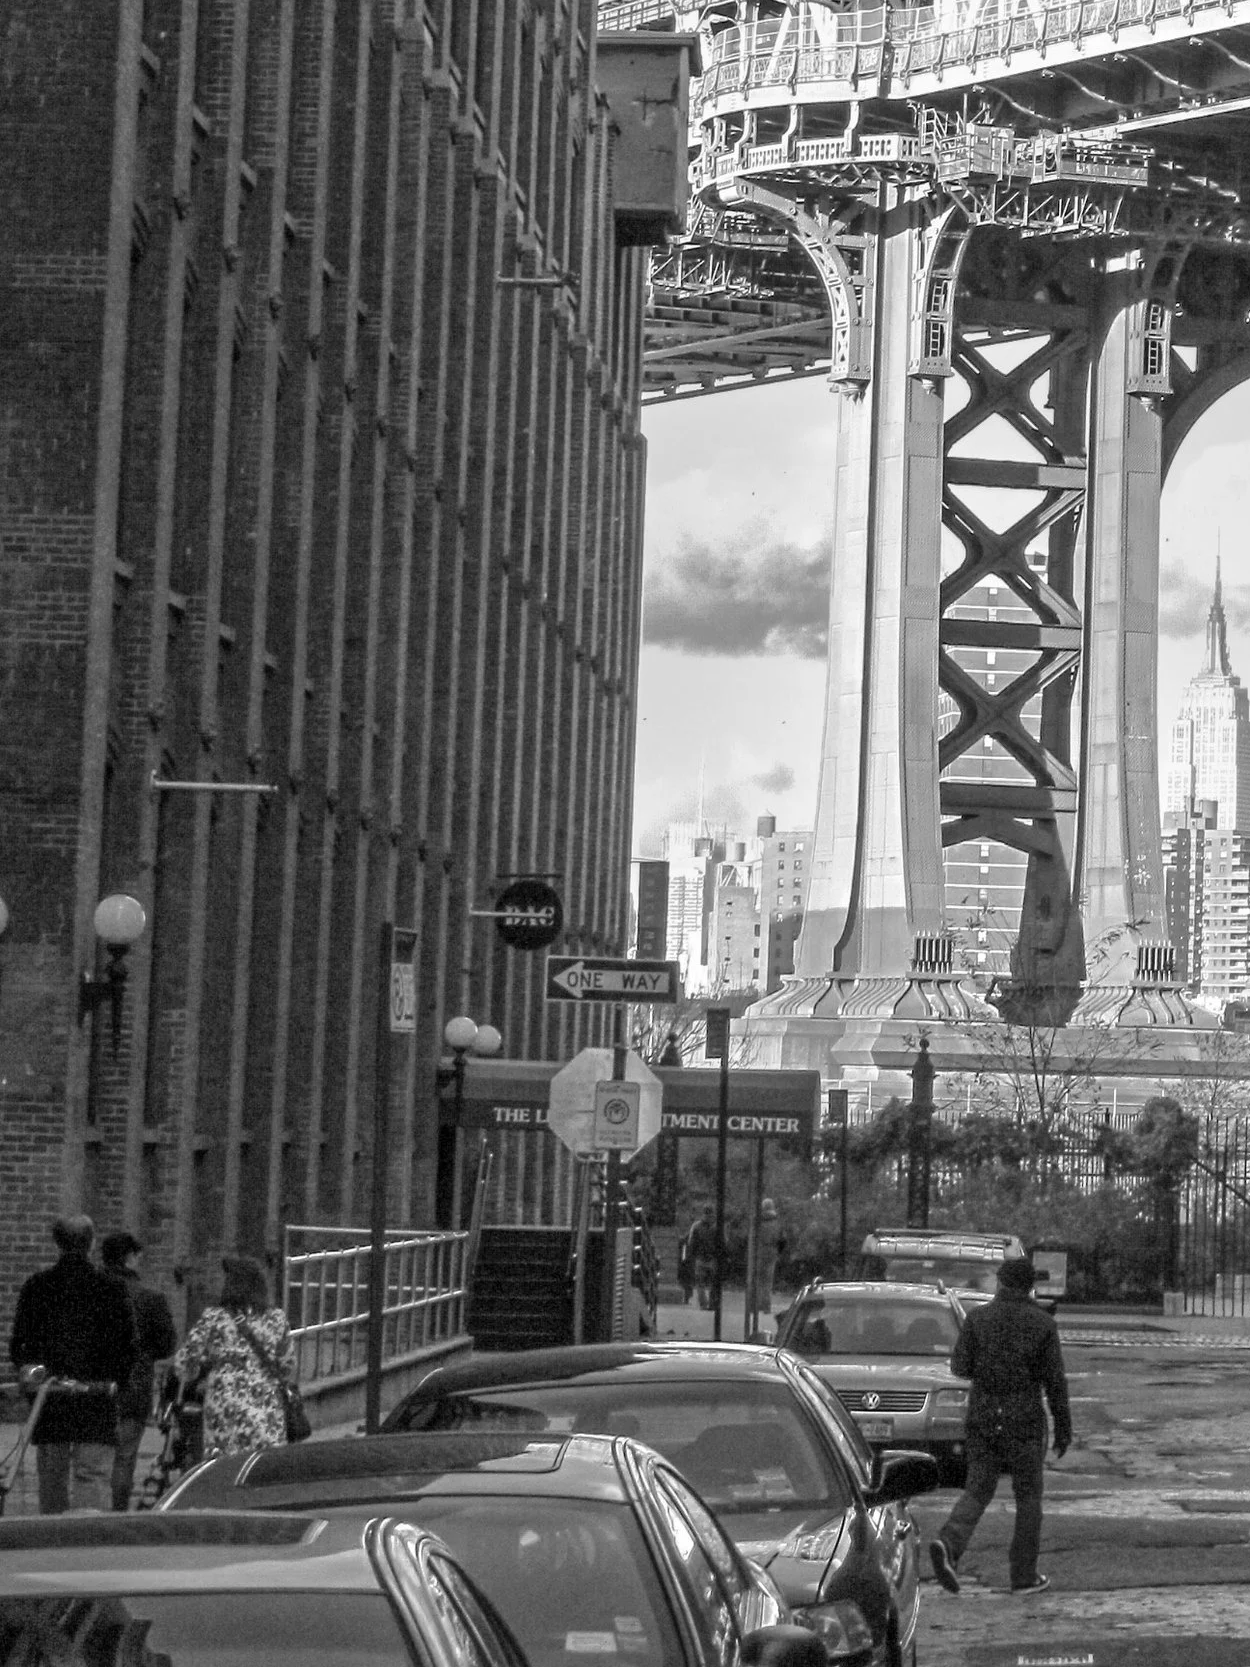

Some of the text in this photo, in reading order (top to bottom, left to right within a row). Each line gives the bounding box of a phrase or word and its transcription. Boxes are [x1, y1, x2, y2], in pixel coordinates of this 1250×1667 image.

[567, 971, 661, 990] ONE WAY
[493, 1107, 531, 1122] THE
[661, 1113, 720, 1129] TMENT
[727, 1115, 799, 1133] CENTER
